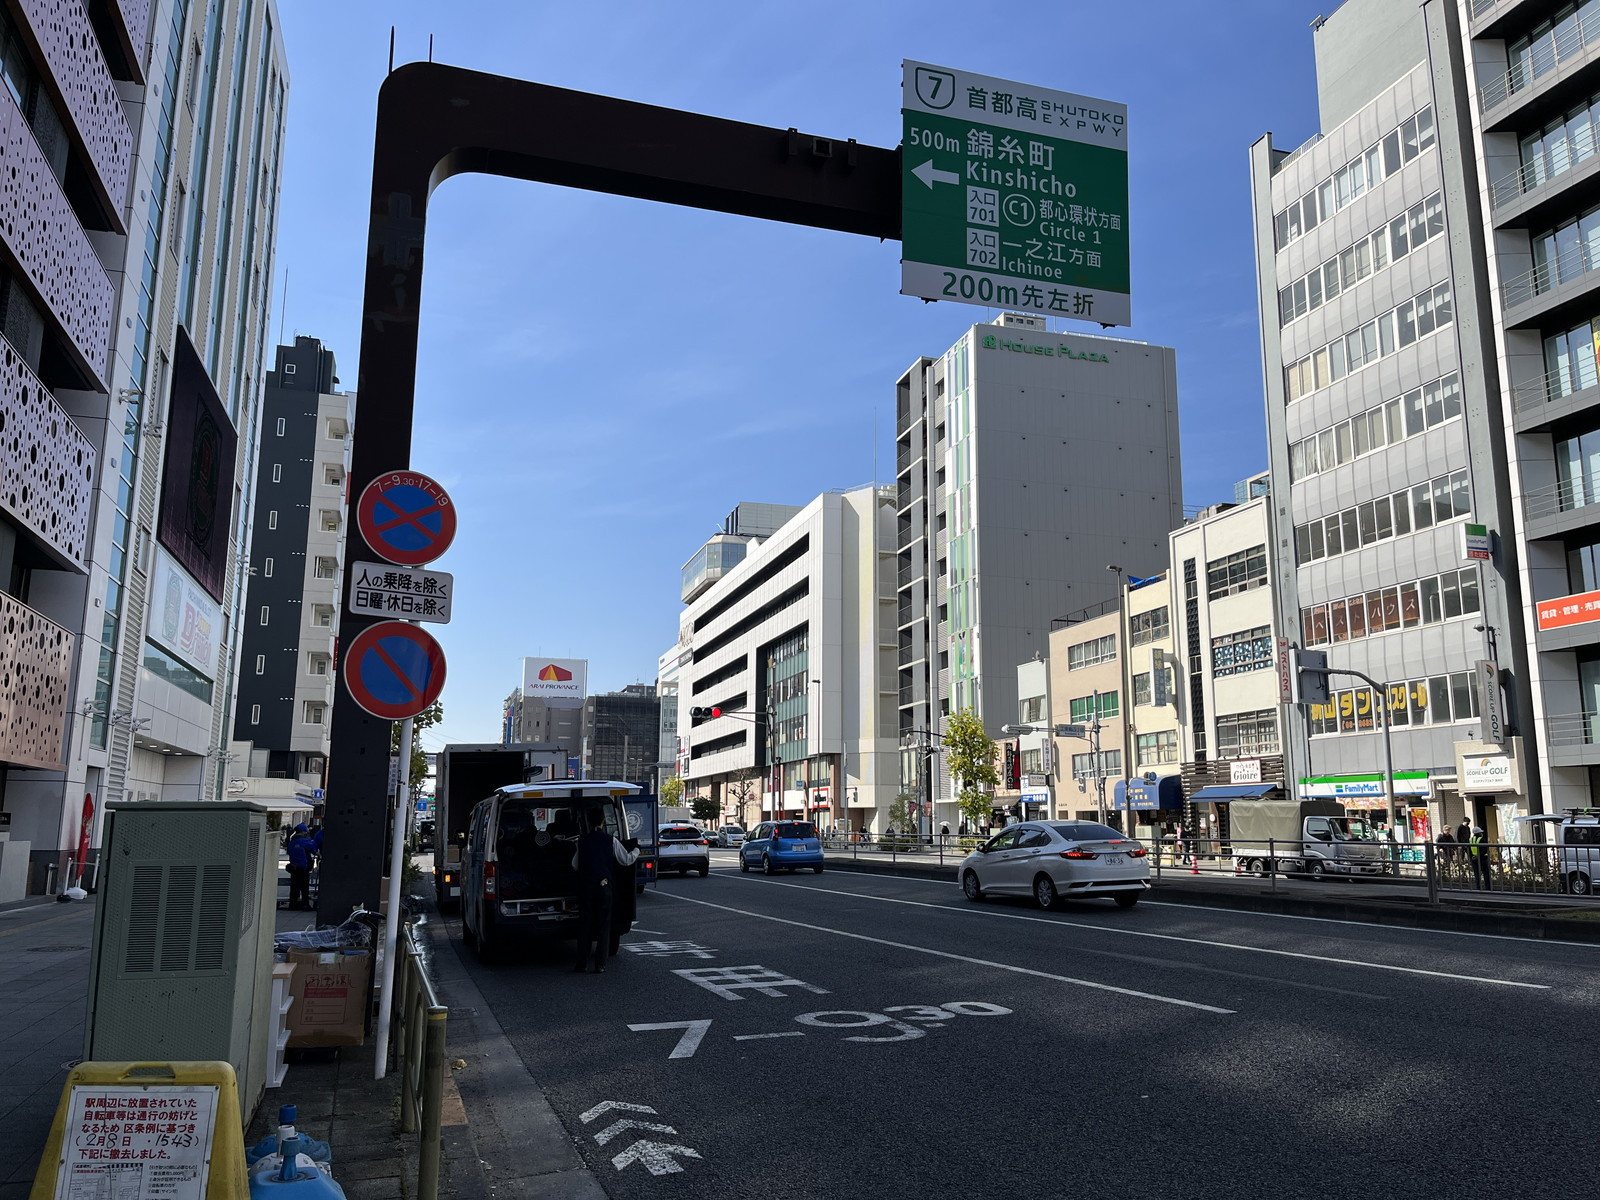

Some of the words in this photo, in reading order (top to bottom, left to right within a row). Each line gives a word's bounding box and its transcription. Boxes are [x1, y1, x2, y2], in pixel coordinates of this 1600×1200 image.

[927, 76, 943, 100] 7
[966, 86, 1038, 122] 首都高
[1040, 100, 1125, 126] SHUTOKO
[910, 127, 961, 154] 500m
[966, 128, 1056, 172] 錦糸町
[966, 160, 1078, 199] Kinshicho
[969, 190, 997, 207] 入口
[1008, 199, 1030, 221] C1
[969, 206, 997, 224] 701
[1039, 198, 1122, 232] 都心環状方面
[969, 231, 997, 249] 入口
[1039, 221, 1087, 243] Circle
[1092, 230, 1102, 245] 1
[969, 248, 997, 267] 702
[1002, 237, 1102, 269] 一之江方面
[1002, 256, 1063, 280] Ichinoe
[356, 568, 448, 597] 人の乗降を除く
[1280, 650, 1290, 692] ベストハウス
[1490, 714, 1501, 741] GOLF
[1233, 770, 1258, 781] Gioire
[1489, 766, 1509, 775] GOLF
[1344, 783, 1379, 793] FamilyMart
[84, 1097, 198, 1109] 駅周辺に放置されていた
[83, 1110, 198, 1122] 自転車等は通行の妨げと
[81, 1123, 120, 1134] なるため
[78, 1148, 172, 1160] 下記に撤去しました。
